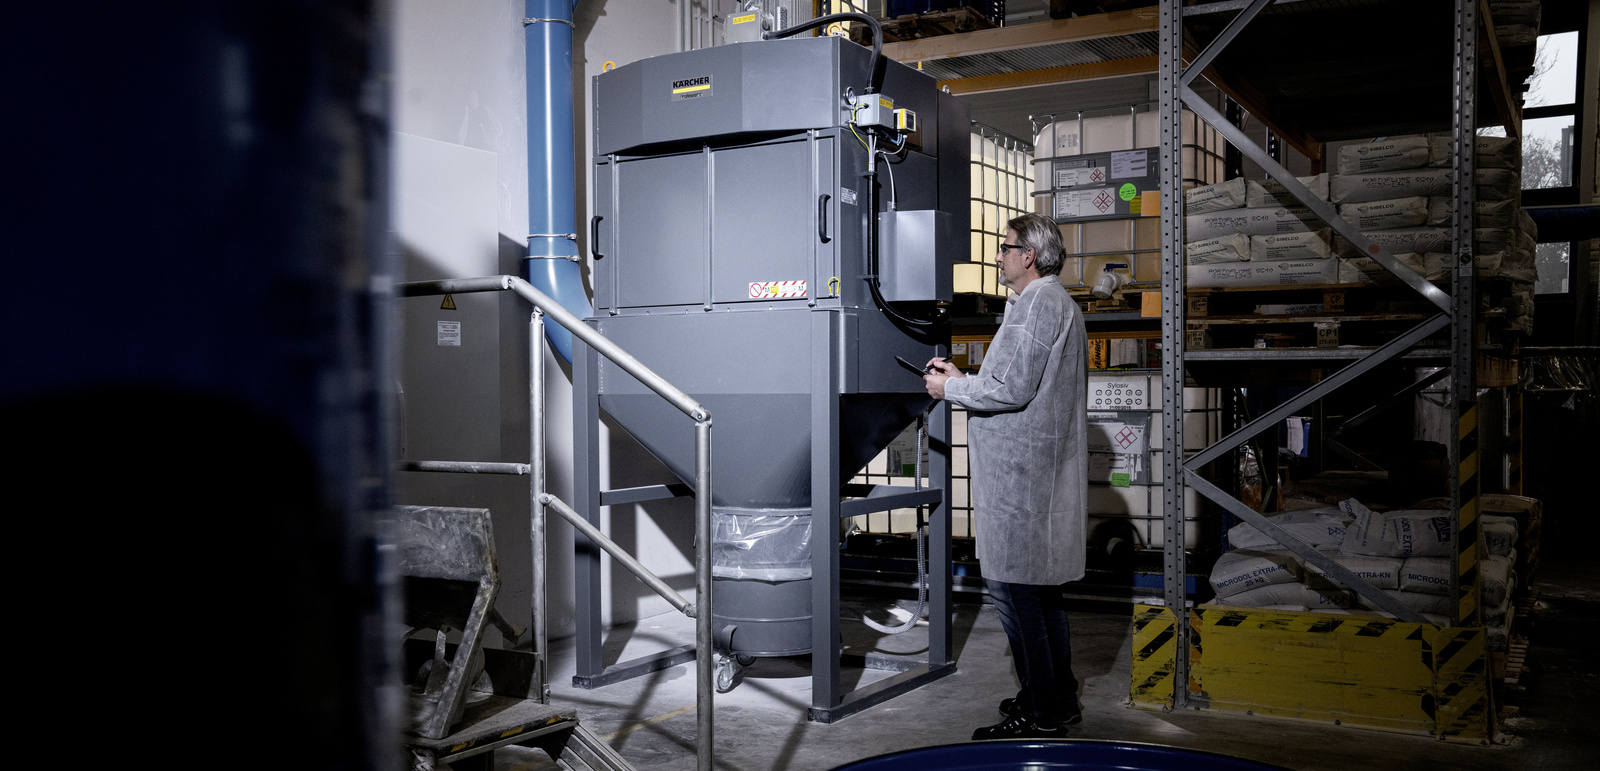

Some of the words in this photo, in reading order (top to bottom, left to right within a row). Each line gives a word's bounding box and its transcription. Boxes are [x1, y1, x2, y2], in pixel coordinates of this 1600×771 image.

[672, 76, 710, 88] KÄRCHER
[1369, 144, 1395, 152] SIBELCO
[1369, 203, 1395, 211] SIBELCO
[1197, 240, 1219, 248] SIBELCO
[1319, 329, 1337, 337] CP1
[1107, 382, 1129, 390] Sylosiv
[1216, 573, 1252, 589] MICRODOL
[1253, 562, 1288, 577] EXTRA-KN
[1408, 573, 1450, 586] MICRODOL
[1244, 579, 1254, 587] 25
[1255, 577, 1265, 585] kg
